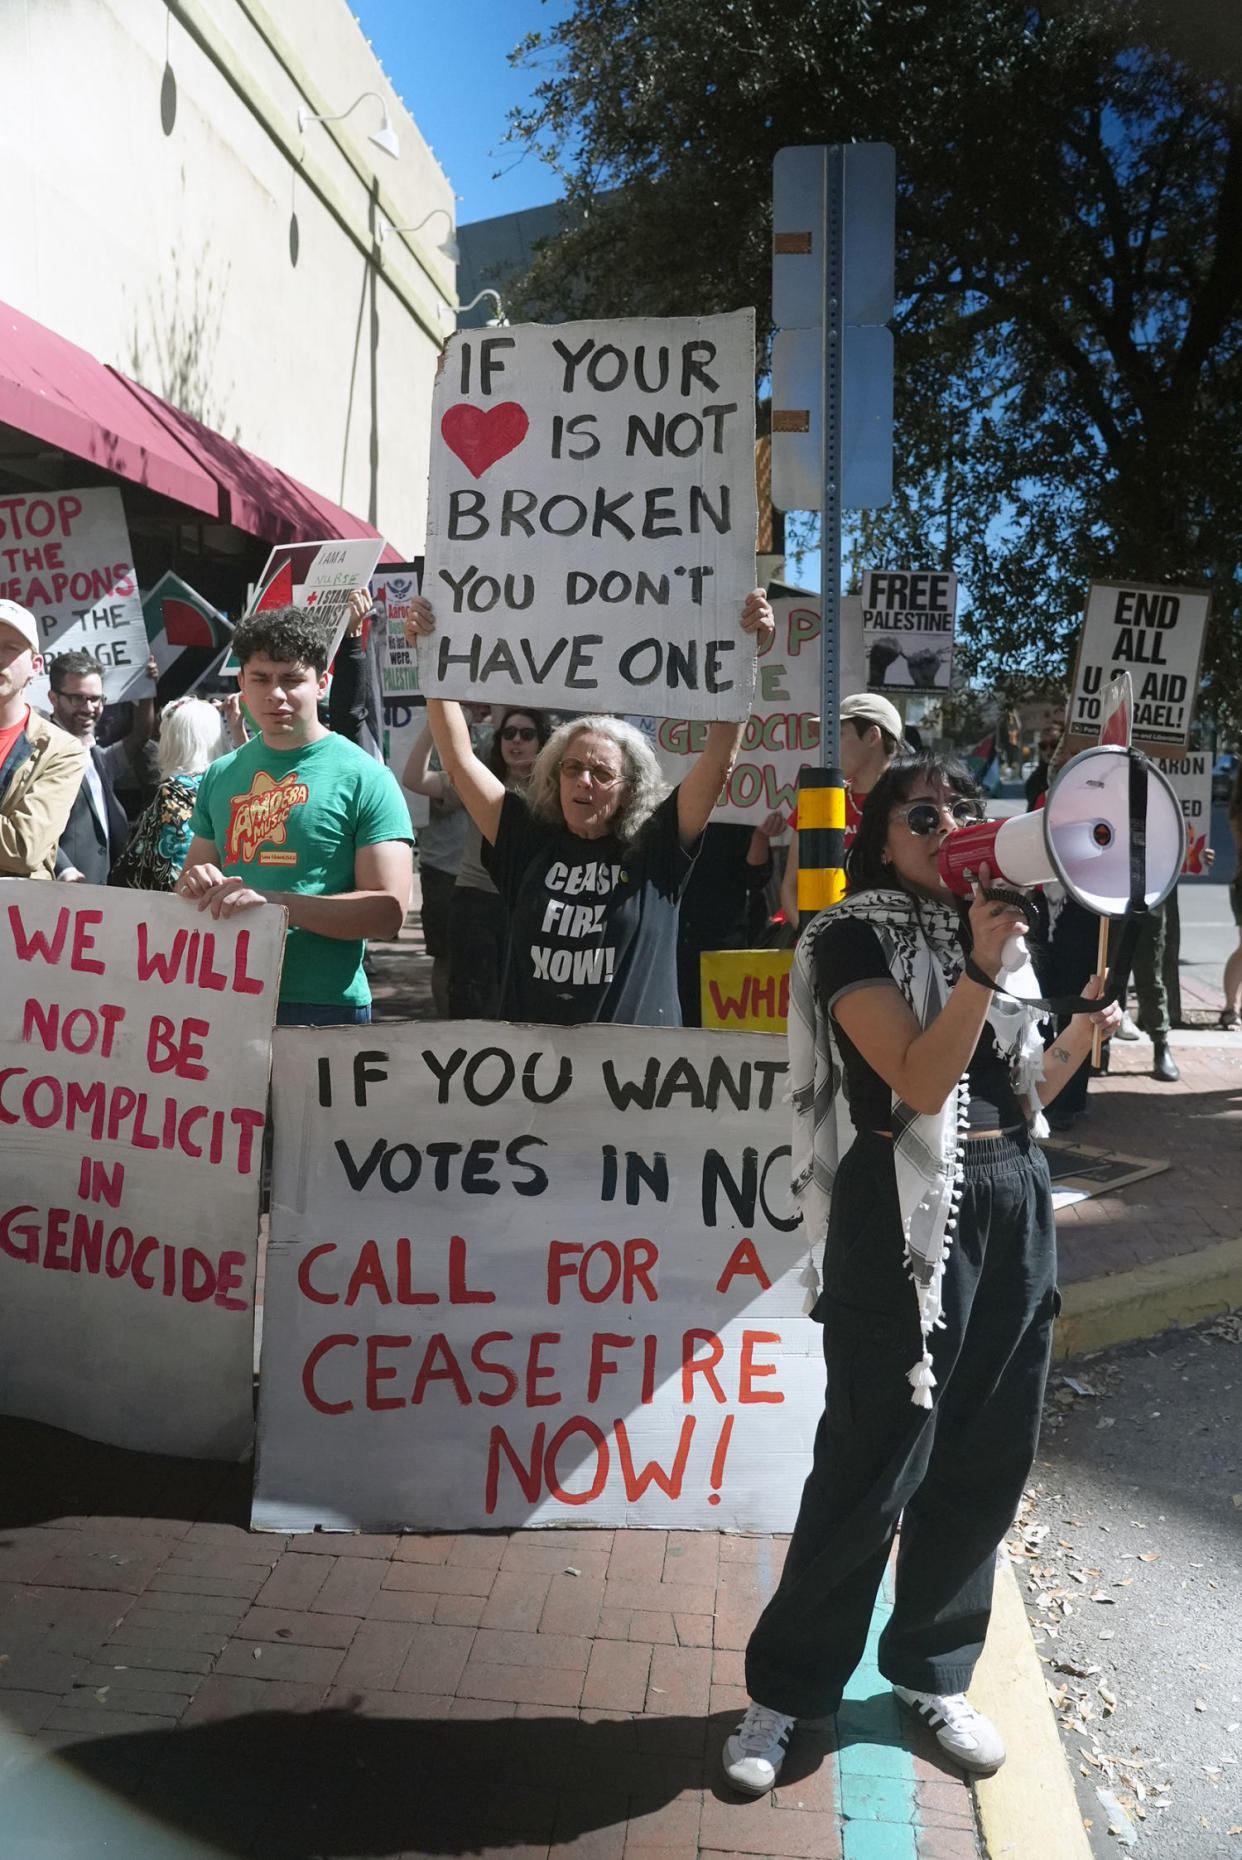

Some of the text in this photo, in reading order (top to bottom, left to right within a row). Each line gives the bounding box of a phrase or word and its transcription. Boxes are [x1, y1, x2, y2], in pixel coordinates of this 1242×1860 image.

[460, 337, 720, 397] IF YOUR
[551, 402, 738, 460] IS NOT
[0, 496, 82, 541] TOP
[447, 485, 732, 541] BROKEN
[2, 542, 65, 573] THE
[438, 565, 714, 613] YOU DON'T
[869, 573, 950, 612] FREE
[1114, 591, 1180, 630] END
[72, 604, 130, 632] THE
[863, 610, 953, 632] PALESTINE
[437, 634, 603, 688] HAVE
[619, 638, 735, 693] ONE
[1111, 628, 1167, 666] ALL
[1078, 697, 1184, 729] TO RAEL!
[1139, 672, 1188, 703] AID
[659, 713, 821, 755] GEOCID
[1159, 757, 1205, 775] ARON
[232, 785, 307, 855] AMOEBA
[254, 808, 290, 843] MUSIC
[8, 904, 265, 995] WE WILL
[23, 998, 210, 1081] NOT BE
[318, 1046, 791, 1111] IF YOU WANT
[0, 1066, 265, 1174] COMPLICIT
[78, 1156, 125, 1208] IN
[334, 1134, 804, 1232] VOTES IN NO
[0, 1205, 249, 1311] GENOCIDE
[298, 1235, 772, 1306] CALL FOR A
[486, 1414, 735, 1514] NOW!
